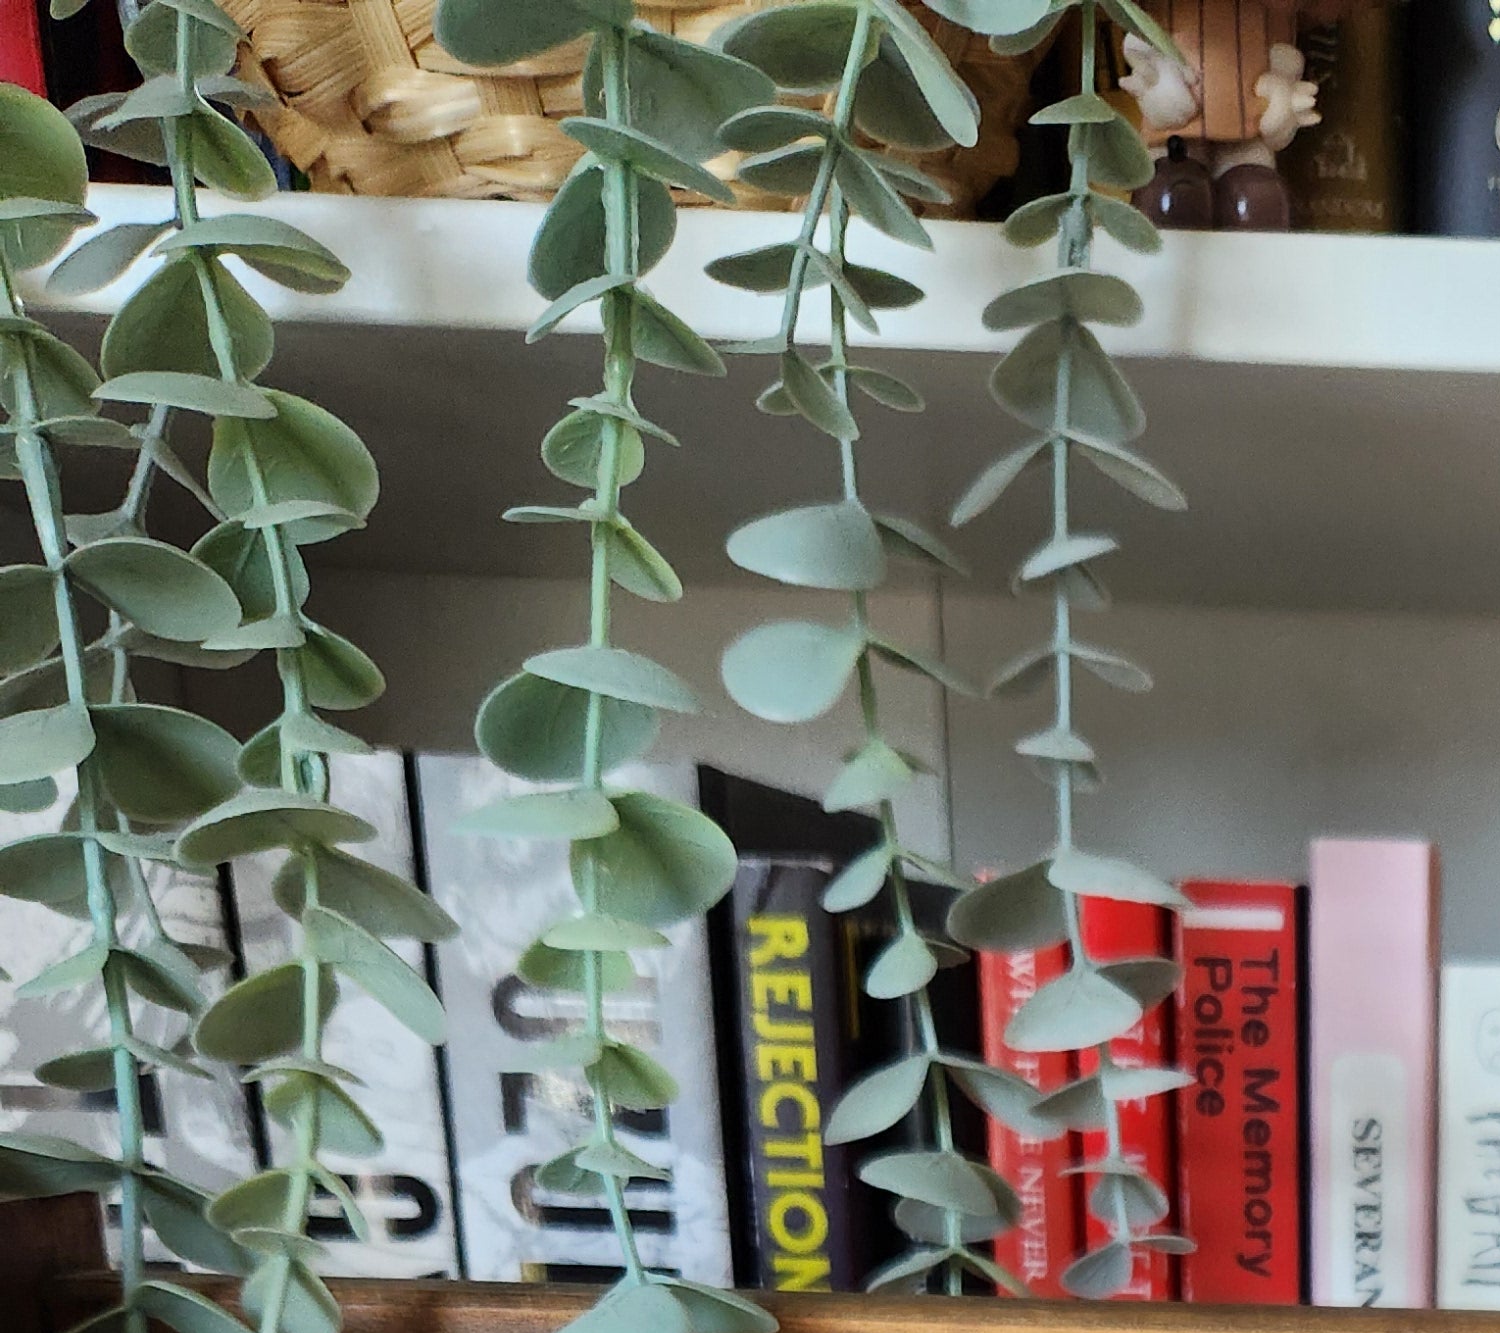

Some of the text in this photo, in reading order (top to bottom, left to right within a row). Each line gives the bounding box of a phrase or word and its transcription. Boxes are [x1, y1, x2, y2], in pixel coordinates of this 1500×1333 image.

[748, 913, 833, 1293] REJECTION
[1192, 956, 1233, 1118] Police
[1235, 950, 1281, 1279] The Memory
